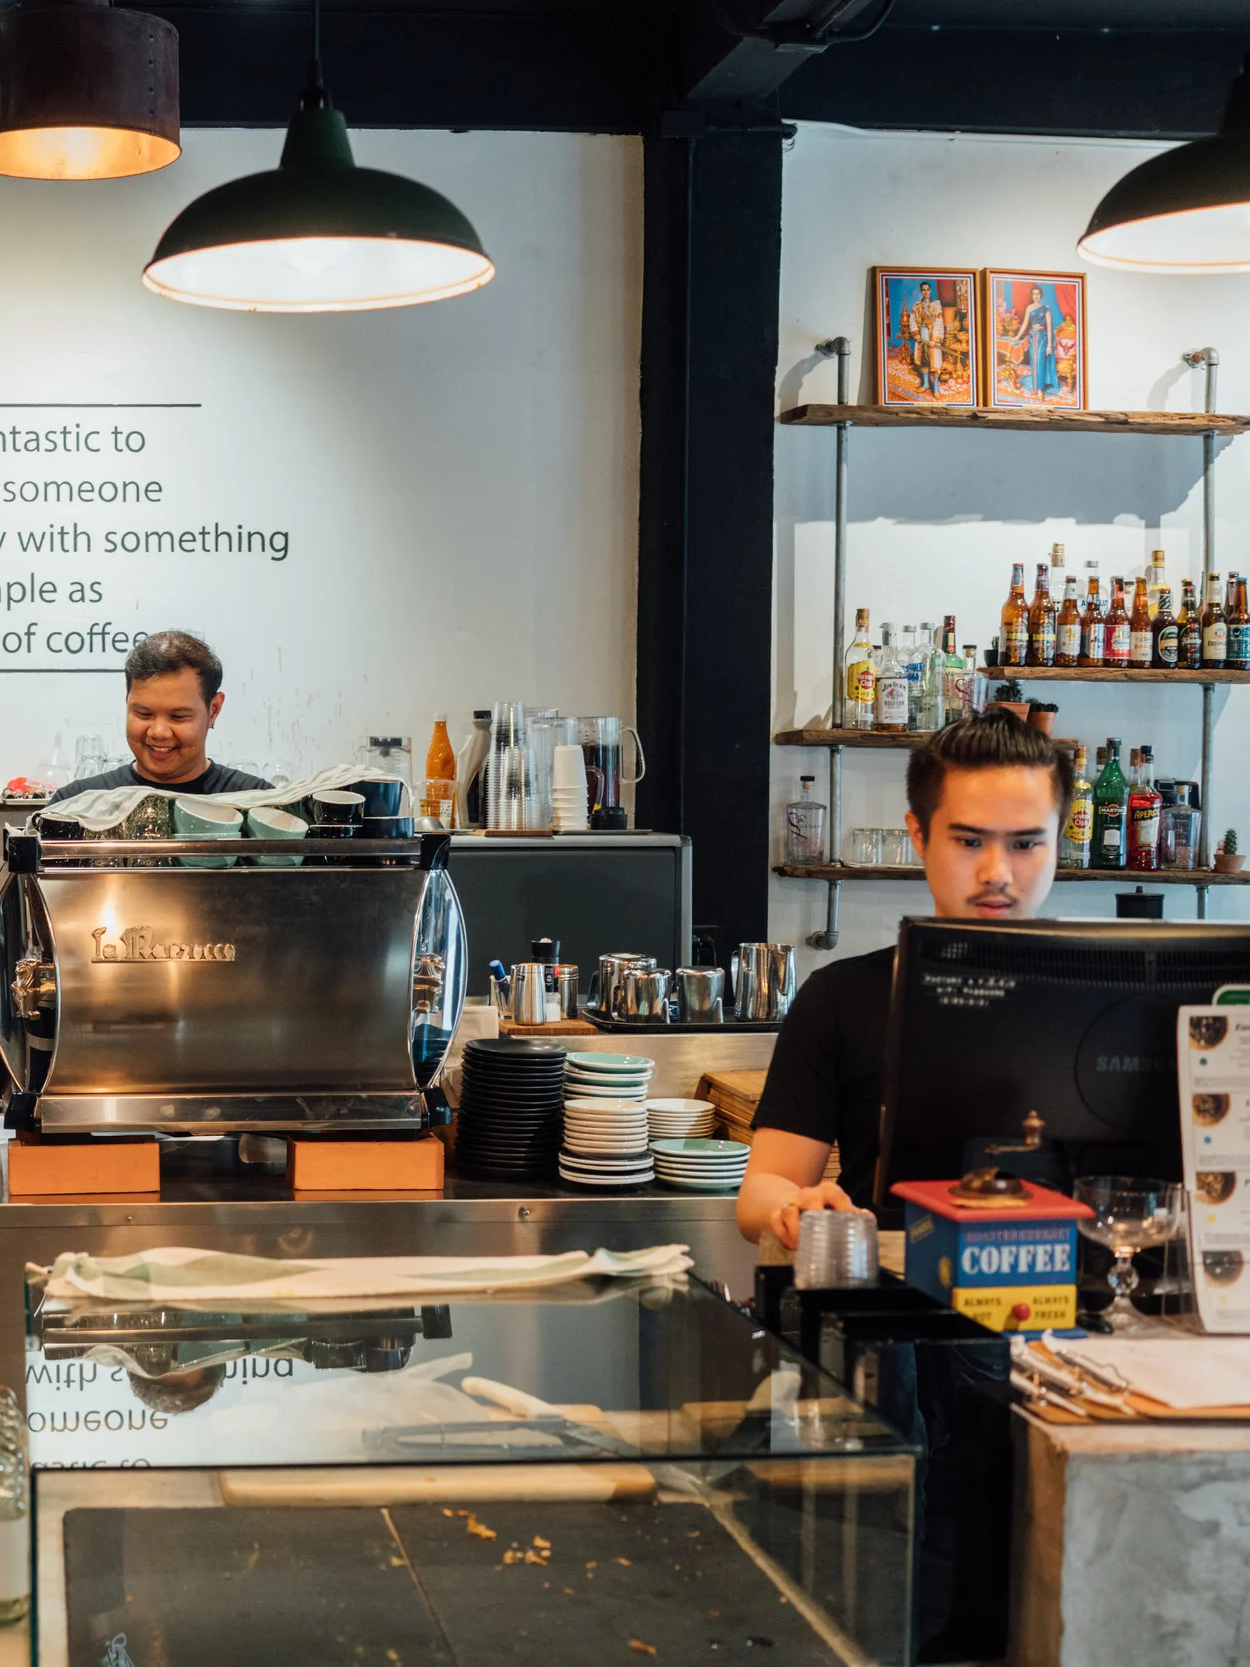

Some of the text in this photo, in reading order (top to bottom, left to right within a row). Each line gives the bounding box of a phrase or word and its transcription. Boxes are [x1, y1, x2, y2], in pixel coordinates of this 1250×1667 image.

[111, 425, 146, 453] to
[2, 479, 163, 503] someone
[17, 523, 91, 553] with
[104, 523, 290, 561] something
[68, 580, 103, 604] as
[2, 622, 38, 654] of
[961, 1243, 1071, 1275] COFFEE
